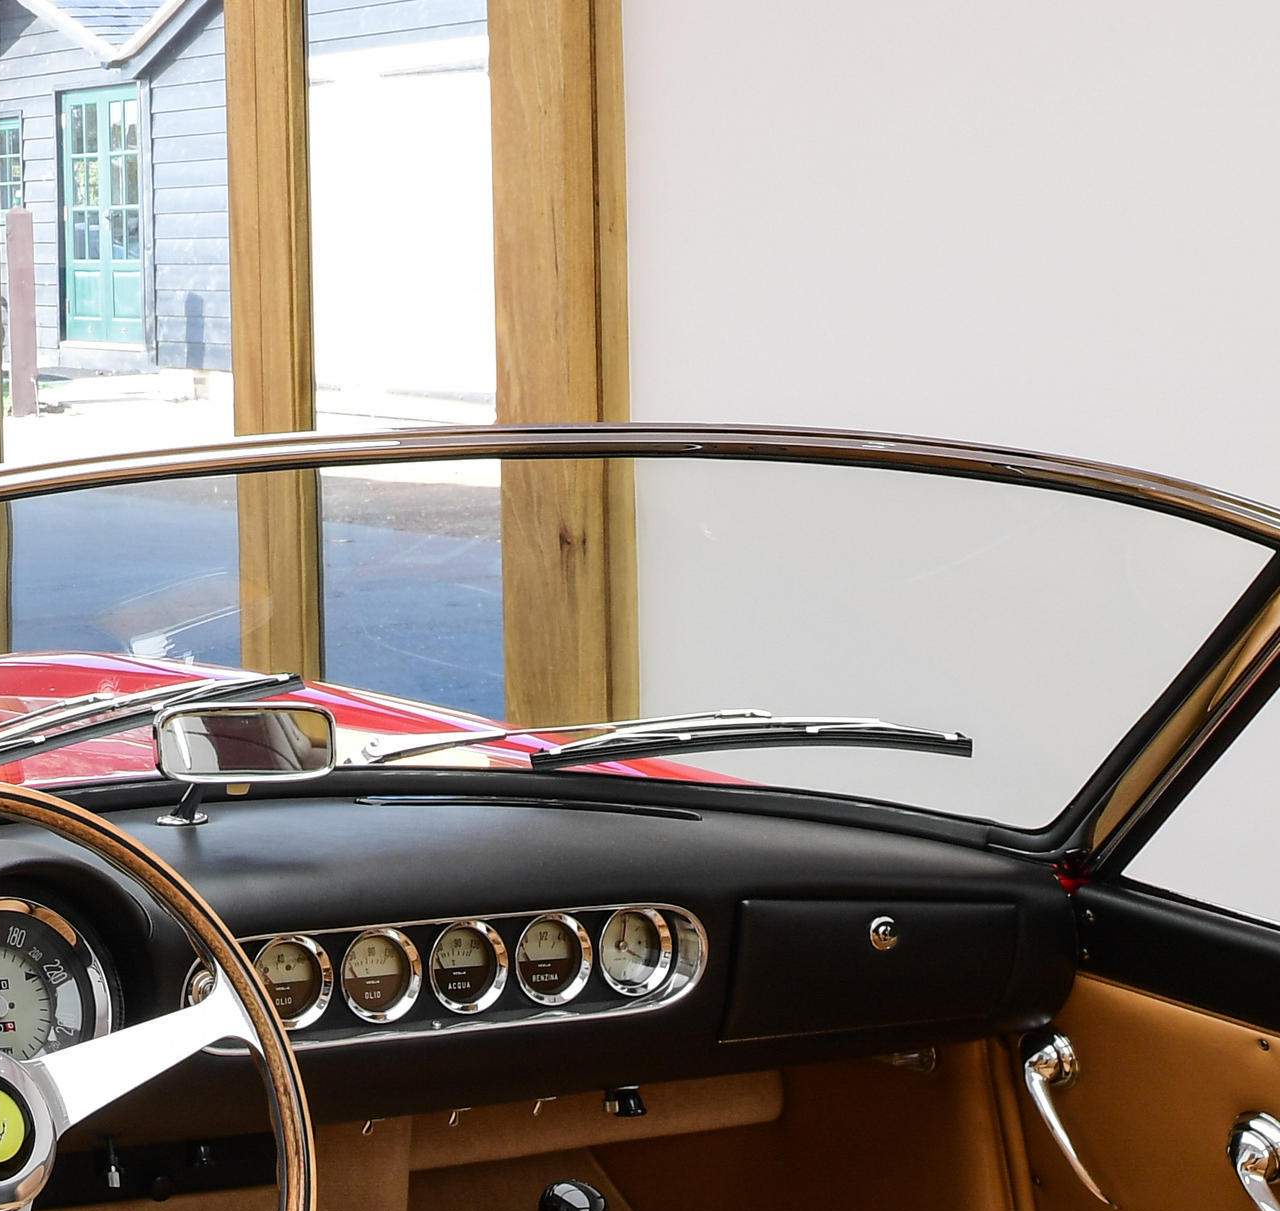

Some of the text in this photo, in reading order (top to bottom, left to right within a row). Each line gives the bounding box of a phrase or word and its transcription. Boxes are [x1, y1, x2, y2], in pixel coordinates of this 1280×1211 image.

[6, 925, 26, 949] 180
[28, 946, 43, 962] 200
[43, 958, 68, 985] 220
[532, 974, 559, 983] BENZINA
[447, 982, 471, 990] ACQUA
[364, 991, 382, 1000] OLIO
[275, 997, 292, 1006] OLIO
